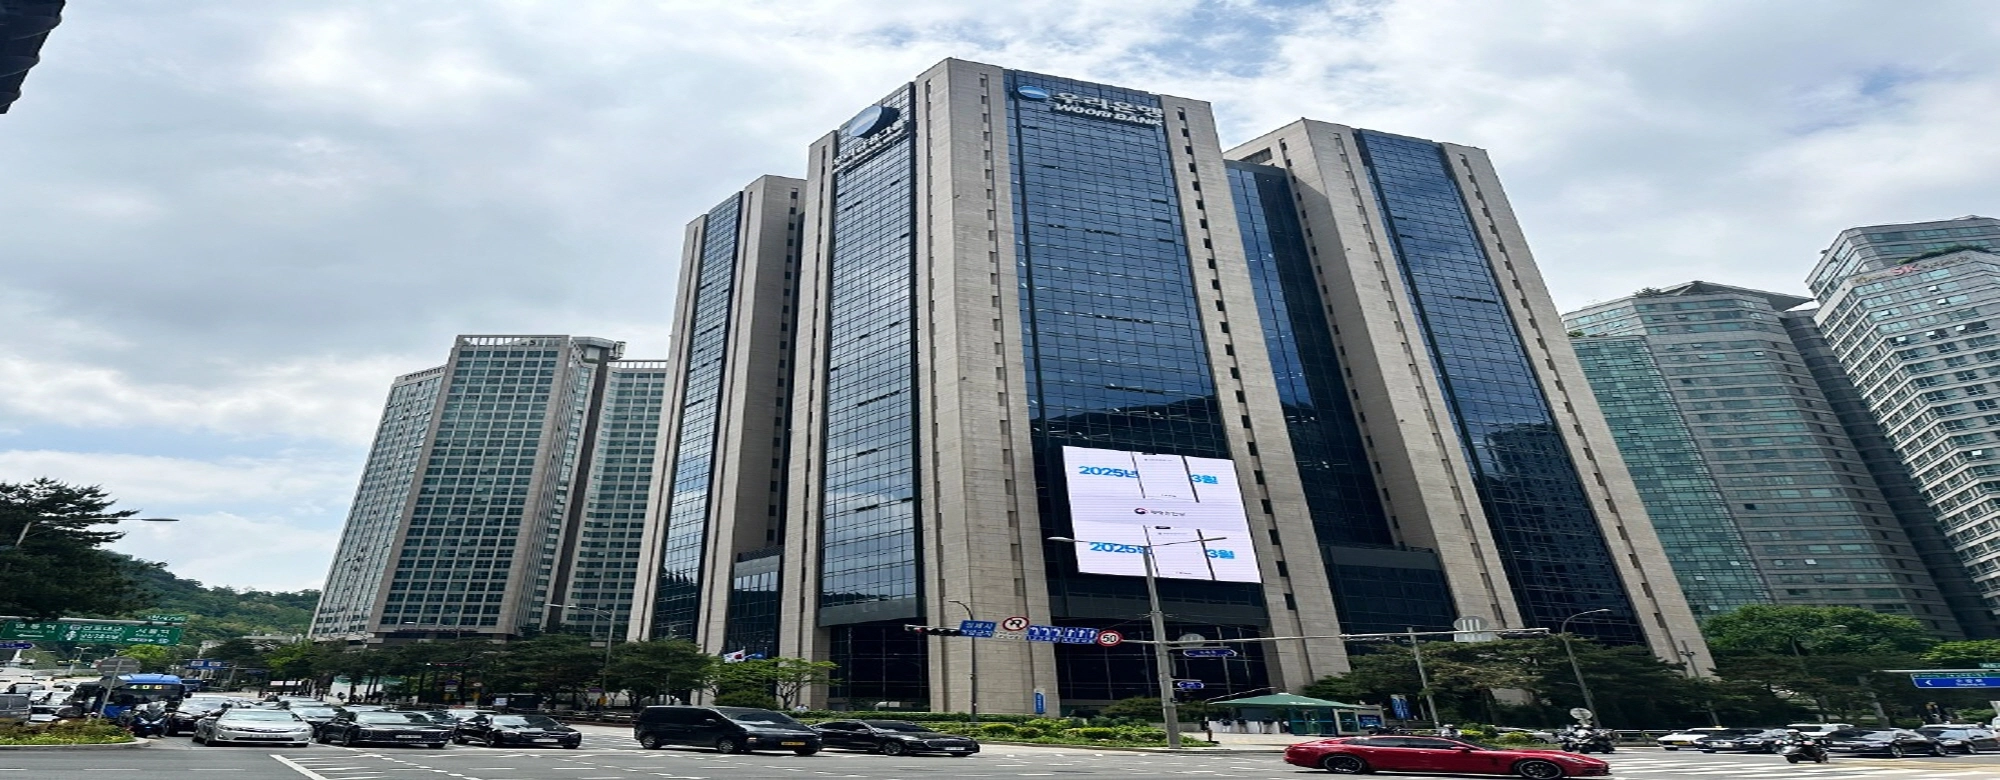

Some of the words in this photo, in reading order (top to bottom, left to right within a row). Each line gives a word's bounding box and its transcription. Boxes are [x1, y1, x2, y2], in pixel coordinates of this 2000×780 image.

[1054, 92, 1163, 118] 우리은행
[1053, 102, 1112, 117] WOORI
[1113, 112, 1164, 127] BANK
[1891, 264, 1920, 275] SK
[1191, 474, 1218, 485] 3월
[1206, 548, 1235, 560] 3월
[1102, 634, 1117, 643] 50
